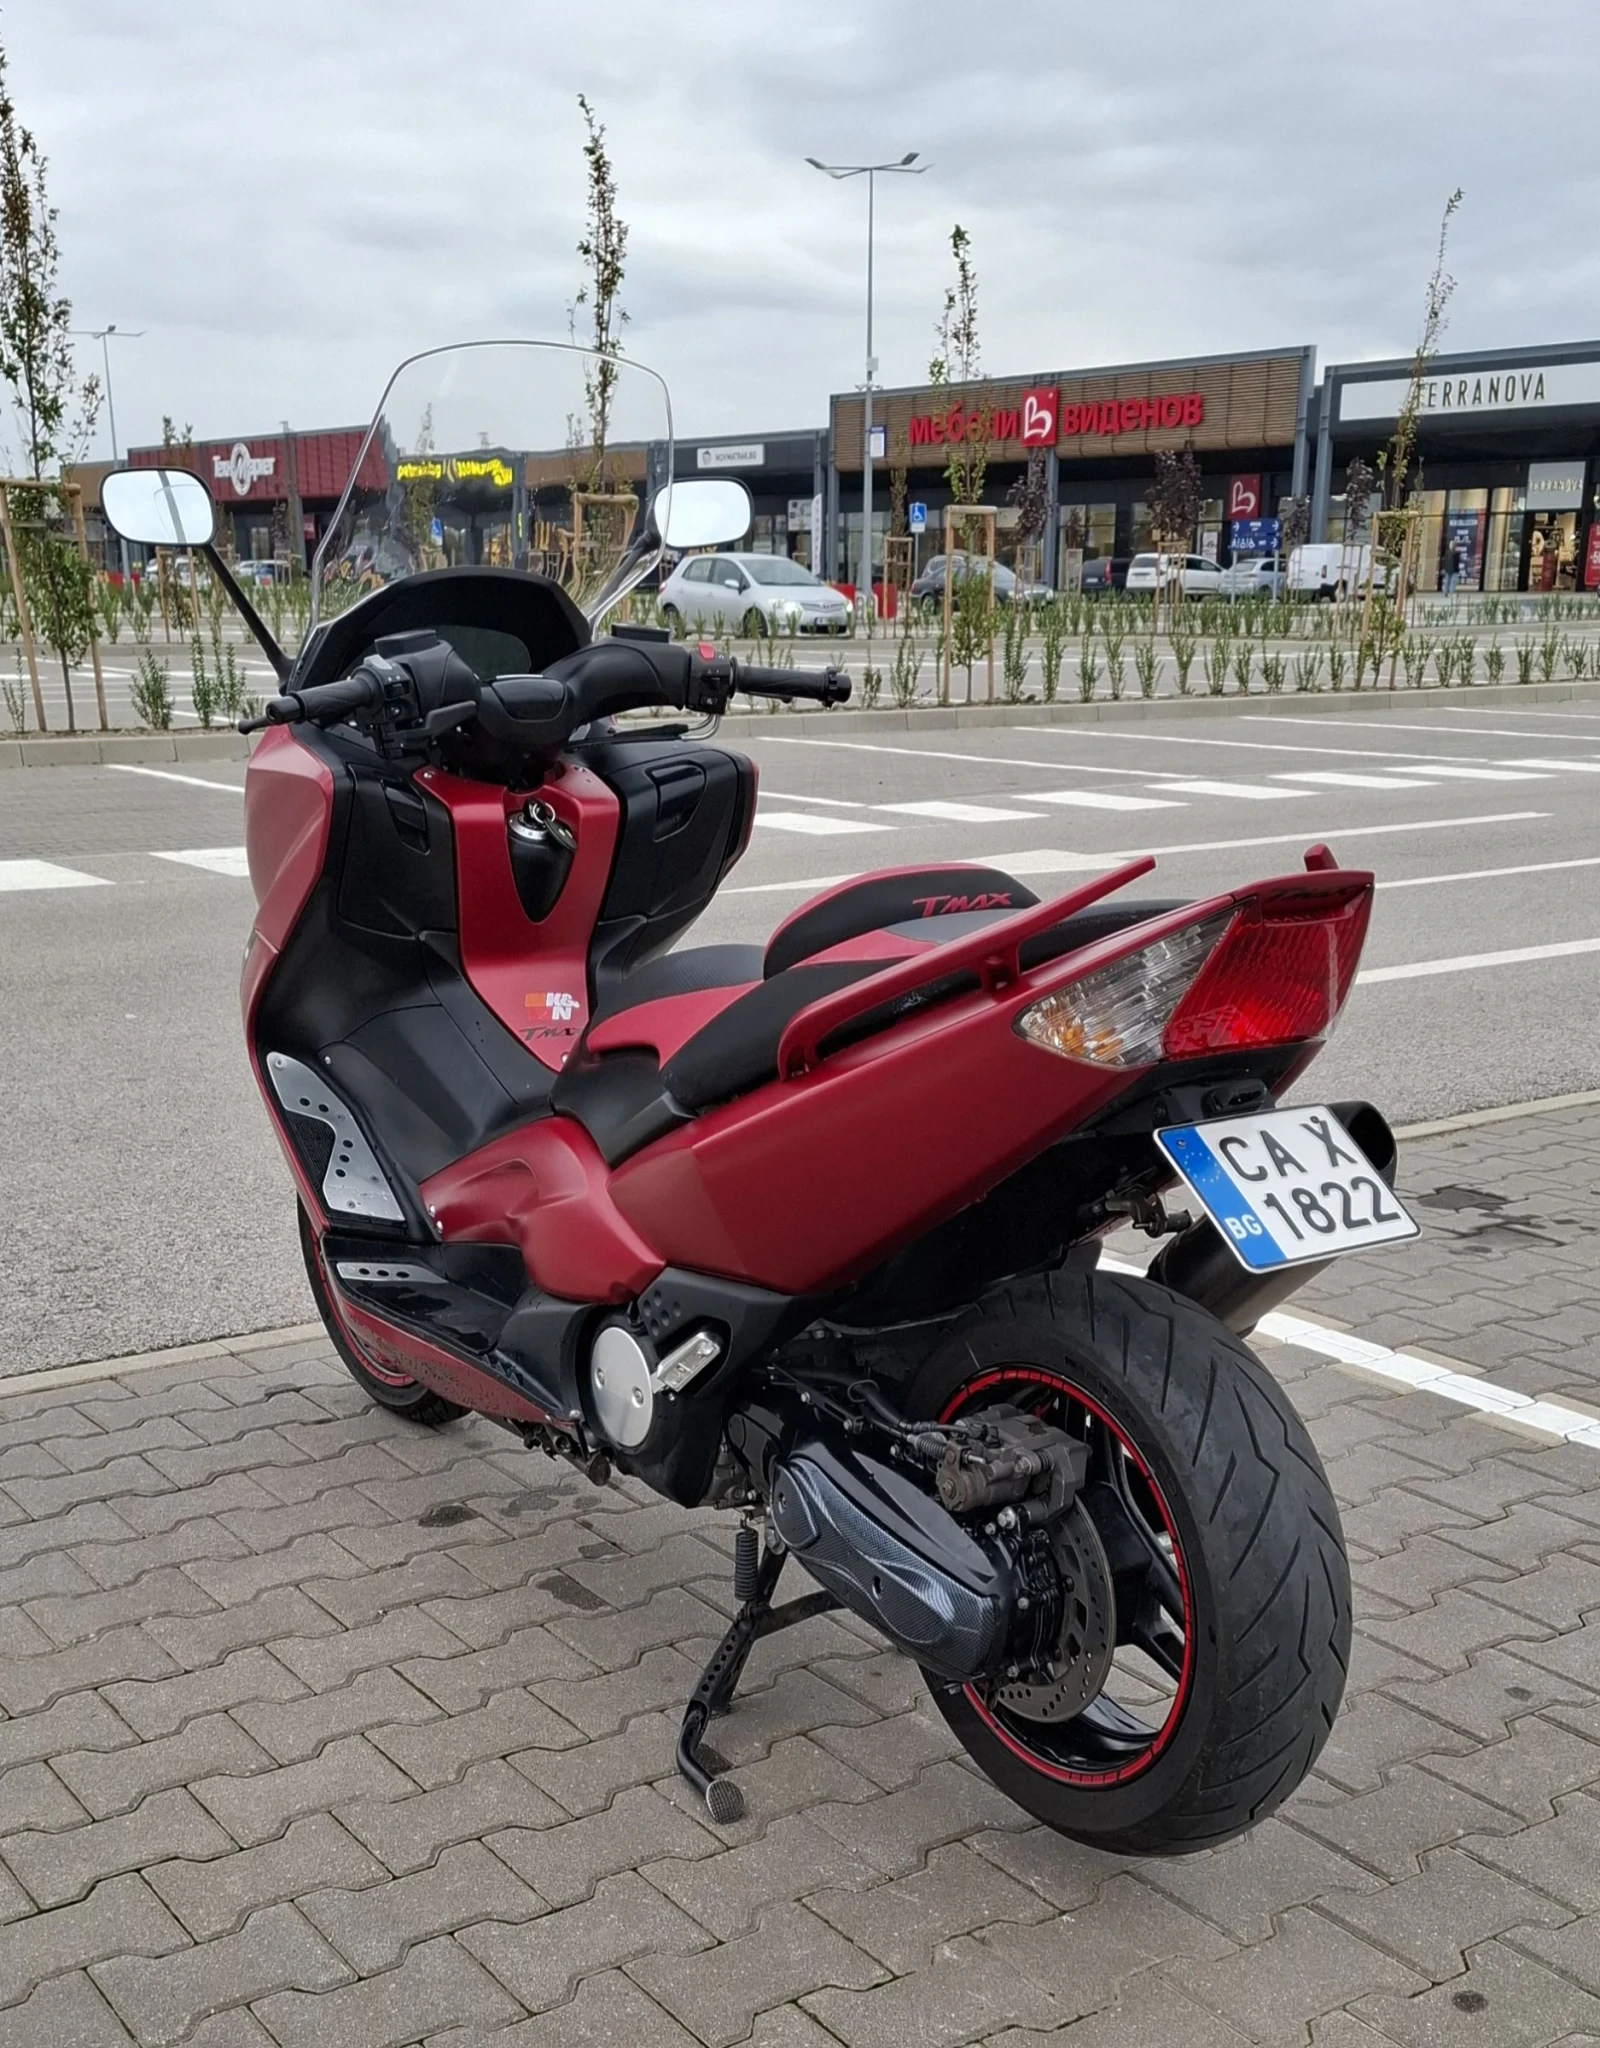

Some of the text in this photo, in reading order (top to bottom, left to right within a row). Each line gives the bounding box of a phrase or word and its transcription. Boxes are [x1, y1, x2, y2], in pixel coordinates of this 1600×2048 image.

[912, 892, 1012, 918] TMAX
[1218, 1118, 1359, 1182] CA X
[1223, 1213, 1263, 1240] BG
[1263, 1175, 1401, 1240] 1822
